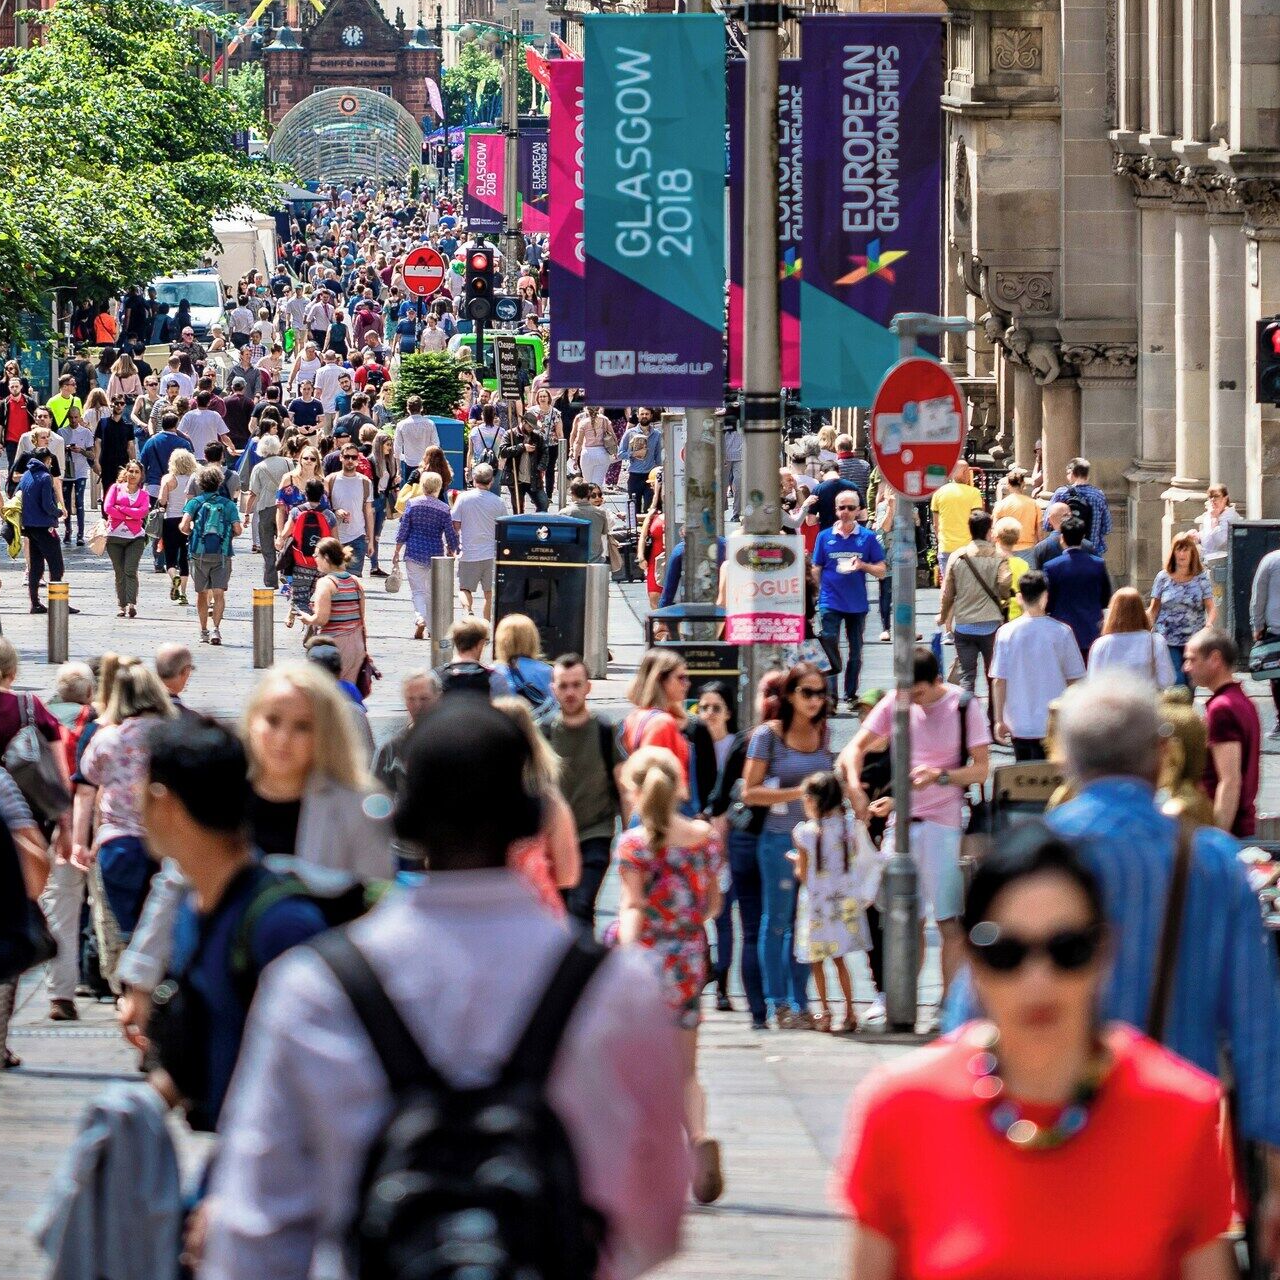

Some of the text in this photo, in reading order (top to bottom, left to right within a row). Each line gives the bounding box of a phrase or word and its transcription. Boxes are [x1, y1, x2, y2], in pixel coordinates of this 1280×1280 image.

[615, 46, 652, 258] GLASGOW
[842, 44, 875, 232] EUROPEAN
[876, 45, 900, 232] CHAMPIONSHIPS
[475, 142, 487, 196] GLASGOW
[486, 172, 497, 196] 2018
[532, 142, 541, 190] EUROPEAN
[540, 142, 548, 190] CHAMPIONSHIPS
[657, 167, 694, 258] 2018
[498, 340, 516, 350] Cheaper
[500, 363, 517, 372] Repairs
[501, 352, 514, 361] Apple
[597, 350, 679, 372] HM Harper
[637, 362, 714, 375] Macleod LLP
